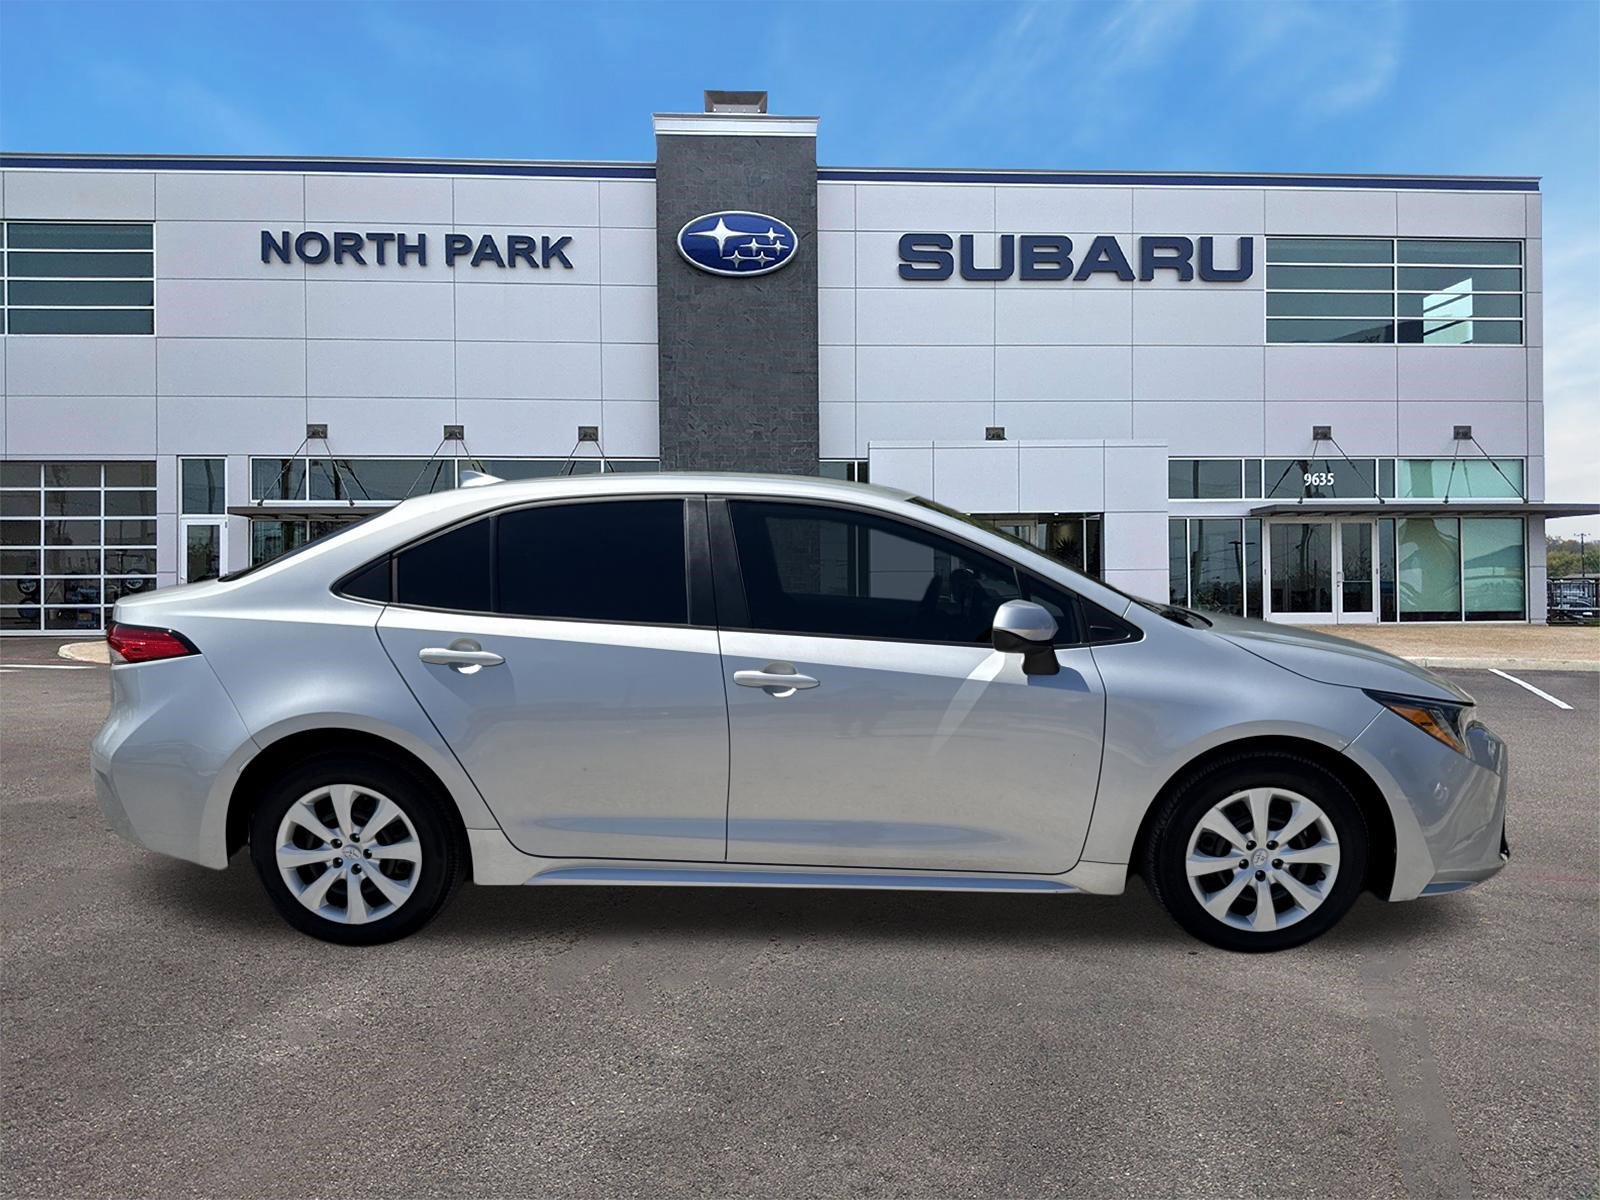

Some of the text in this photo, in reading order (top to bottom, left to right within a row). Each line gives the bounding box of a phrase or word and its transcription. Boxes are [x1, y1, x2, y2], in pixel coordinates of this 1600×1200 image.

[260, 230, 574, 270] NORTH PARK
[898, 233, 1254, 282] SUBARU
[1303, 472, 1335, 486] 9635
